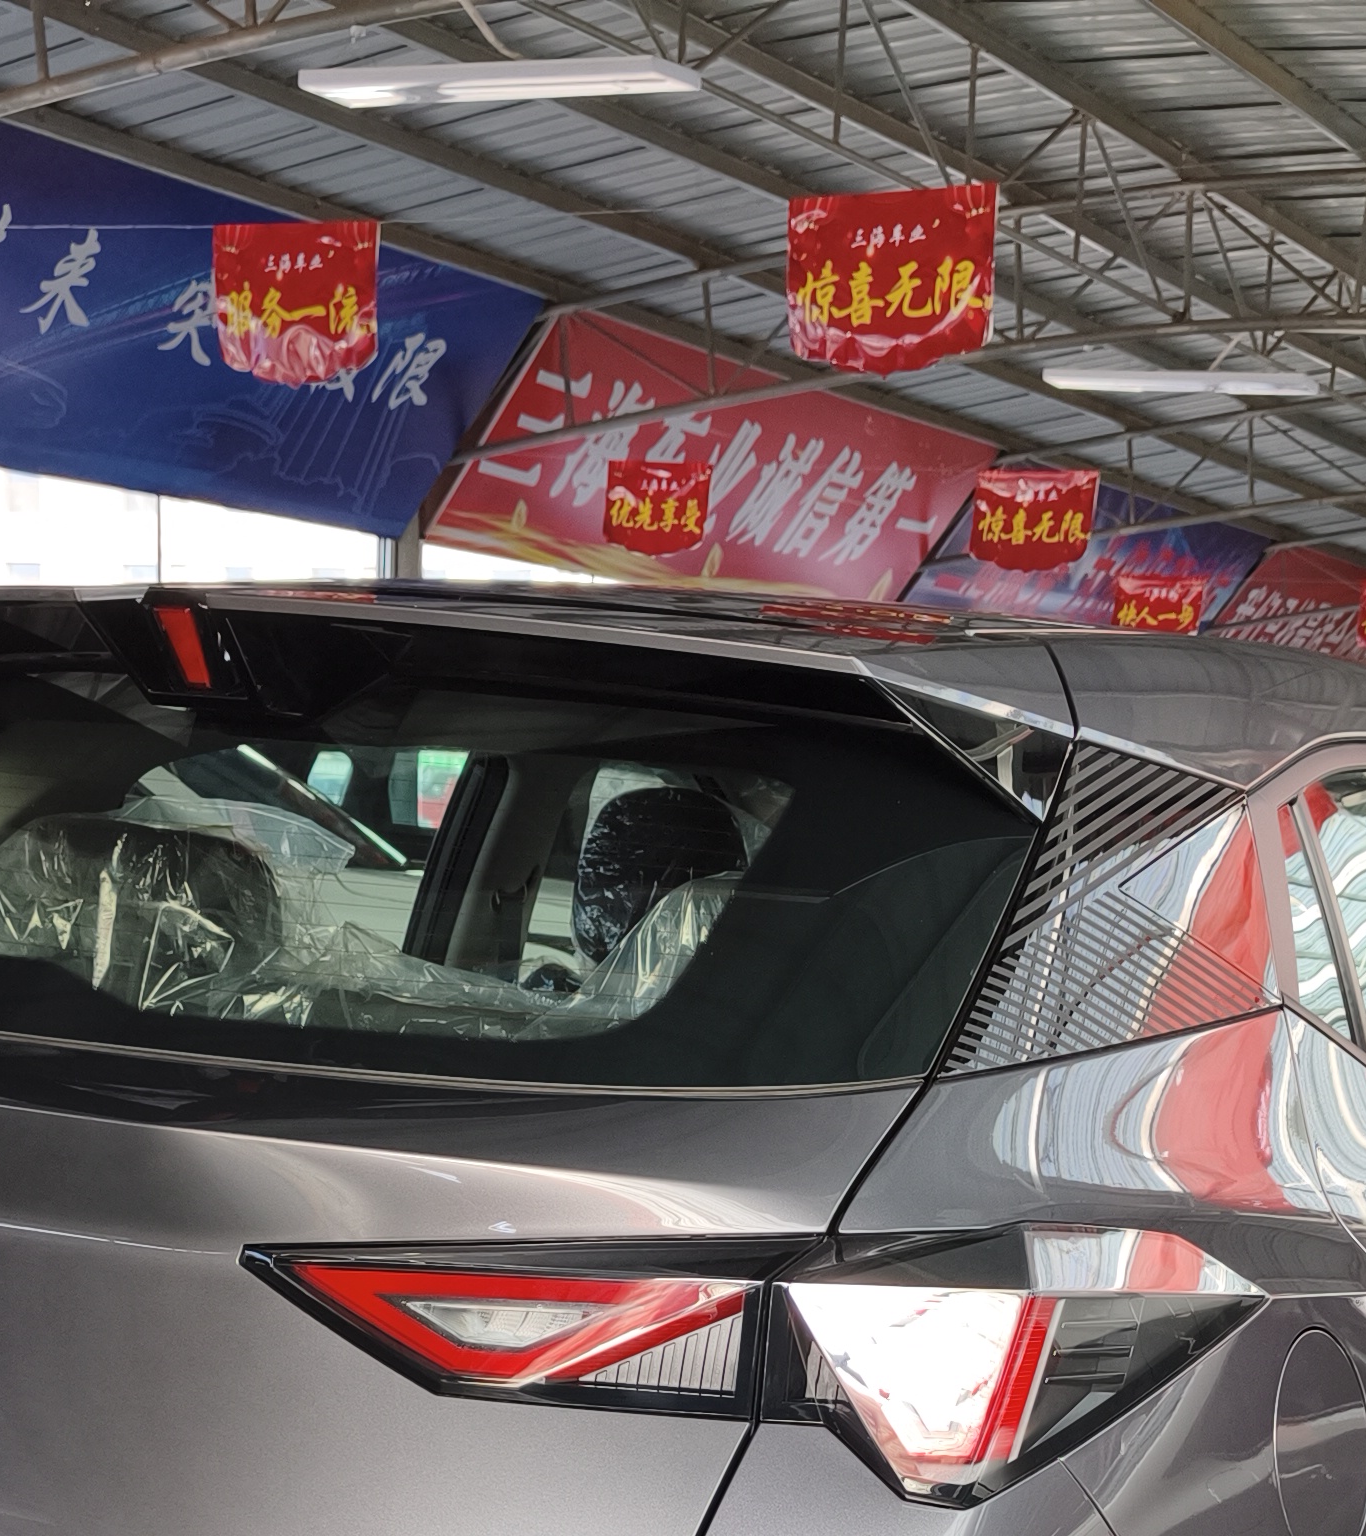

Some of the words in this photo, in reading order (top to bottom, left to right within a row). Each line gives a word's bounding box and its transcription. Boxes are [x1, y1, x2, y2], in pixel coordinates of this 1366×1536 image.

[850, 223, 926, 248] 三海车业
[225, 282, 367, 339] 服务一流
[796, 255, 984, 327] 惊喜无限
[609, 497, 701, 534] 优先享受
[977, 505, 1087, 545] 惊喜无限
